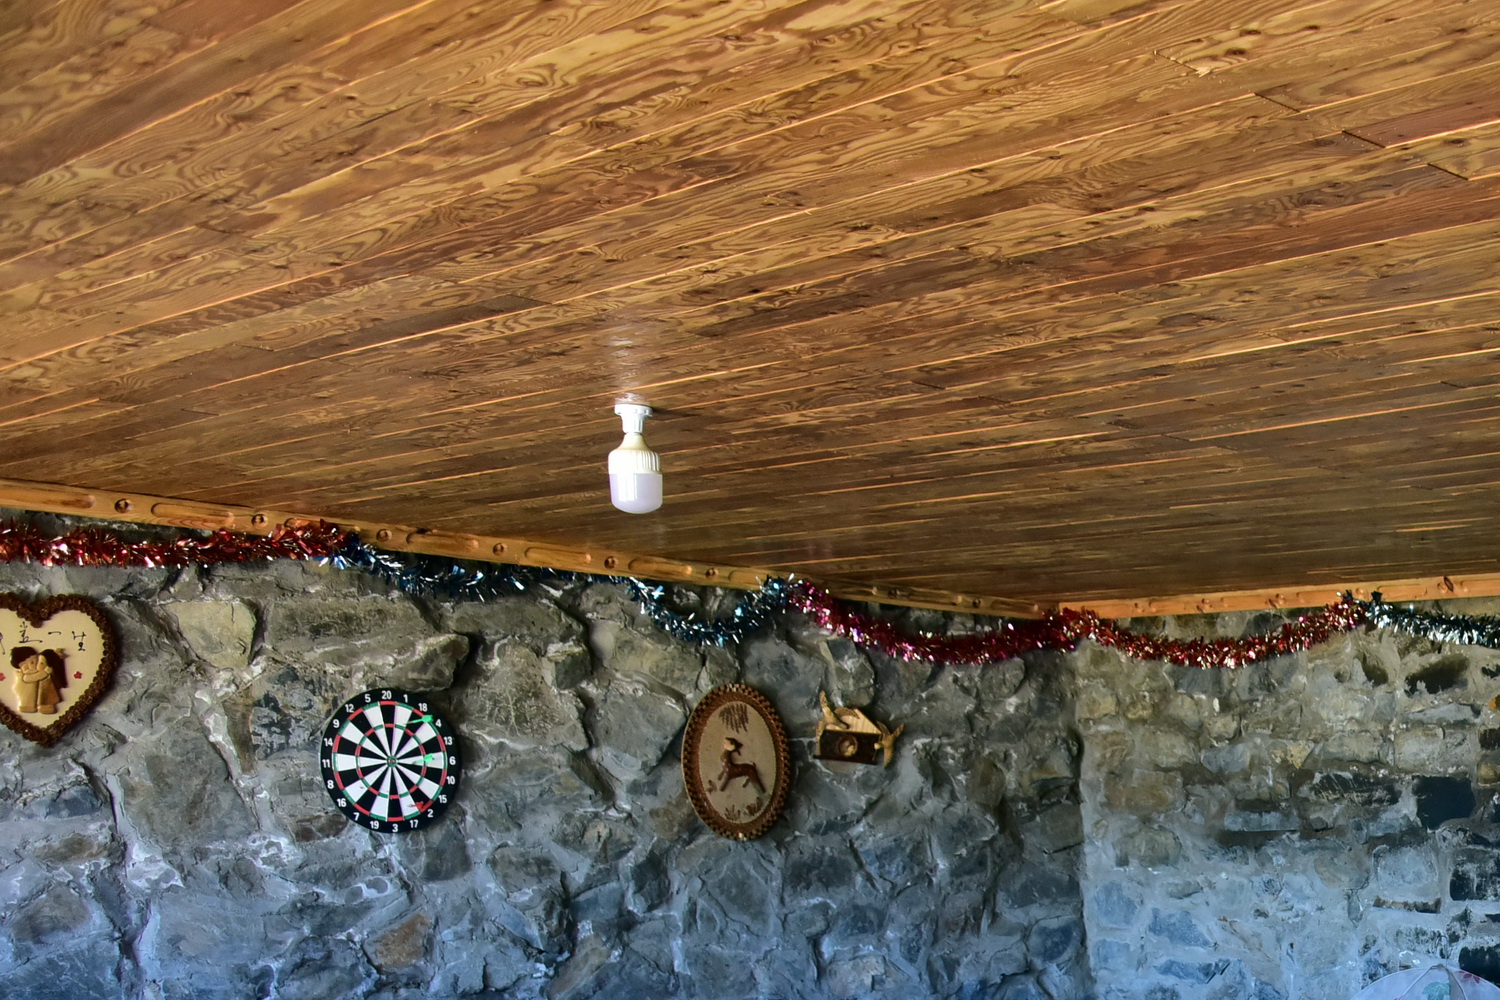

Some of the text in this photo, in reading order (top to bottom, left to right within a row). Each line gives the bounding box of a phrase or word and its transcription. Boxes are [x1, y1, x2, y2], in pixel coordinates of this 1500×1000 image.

[364, 693, 372, 703] 5
[381, 690, 392, 700] 20
[403, 694, 409, 703] 1
[344, 703, 355, 713] 12
[418, 703, 428, 713] 18
[332, 718, 340, 729] 9
[435, 718, 442, 728] 4
[323, 737, 333, 747] 14
[443, 736, 453, 746] 13
[322, 759, 331, 769] 11
[449, 756, 456, 766] 6
[327, 780, 335, 790] 8
[446, 776, 456, 786] 10
[336, 798, 347, 808] 16
[438, 794, 448, 804] 15
[353, 812, 361, 822] 7
[427, 808, 434, 818] 2
[369, 820, 380, 830] 19
[392, 823, 399, 833] 3
[409, 819, 419, 829] 17
